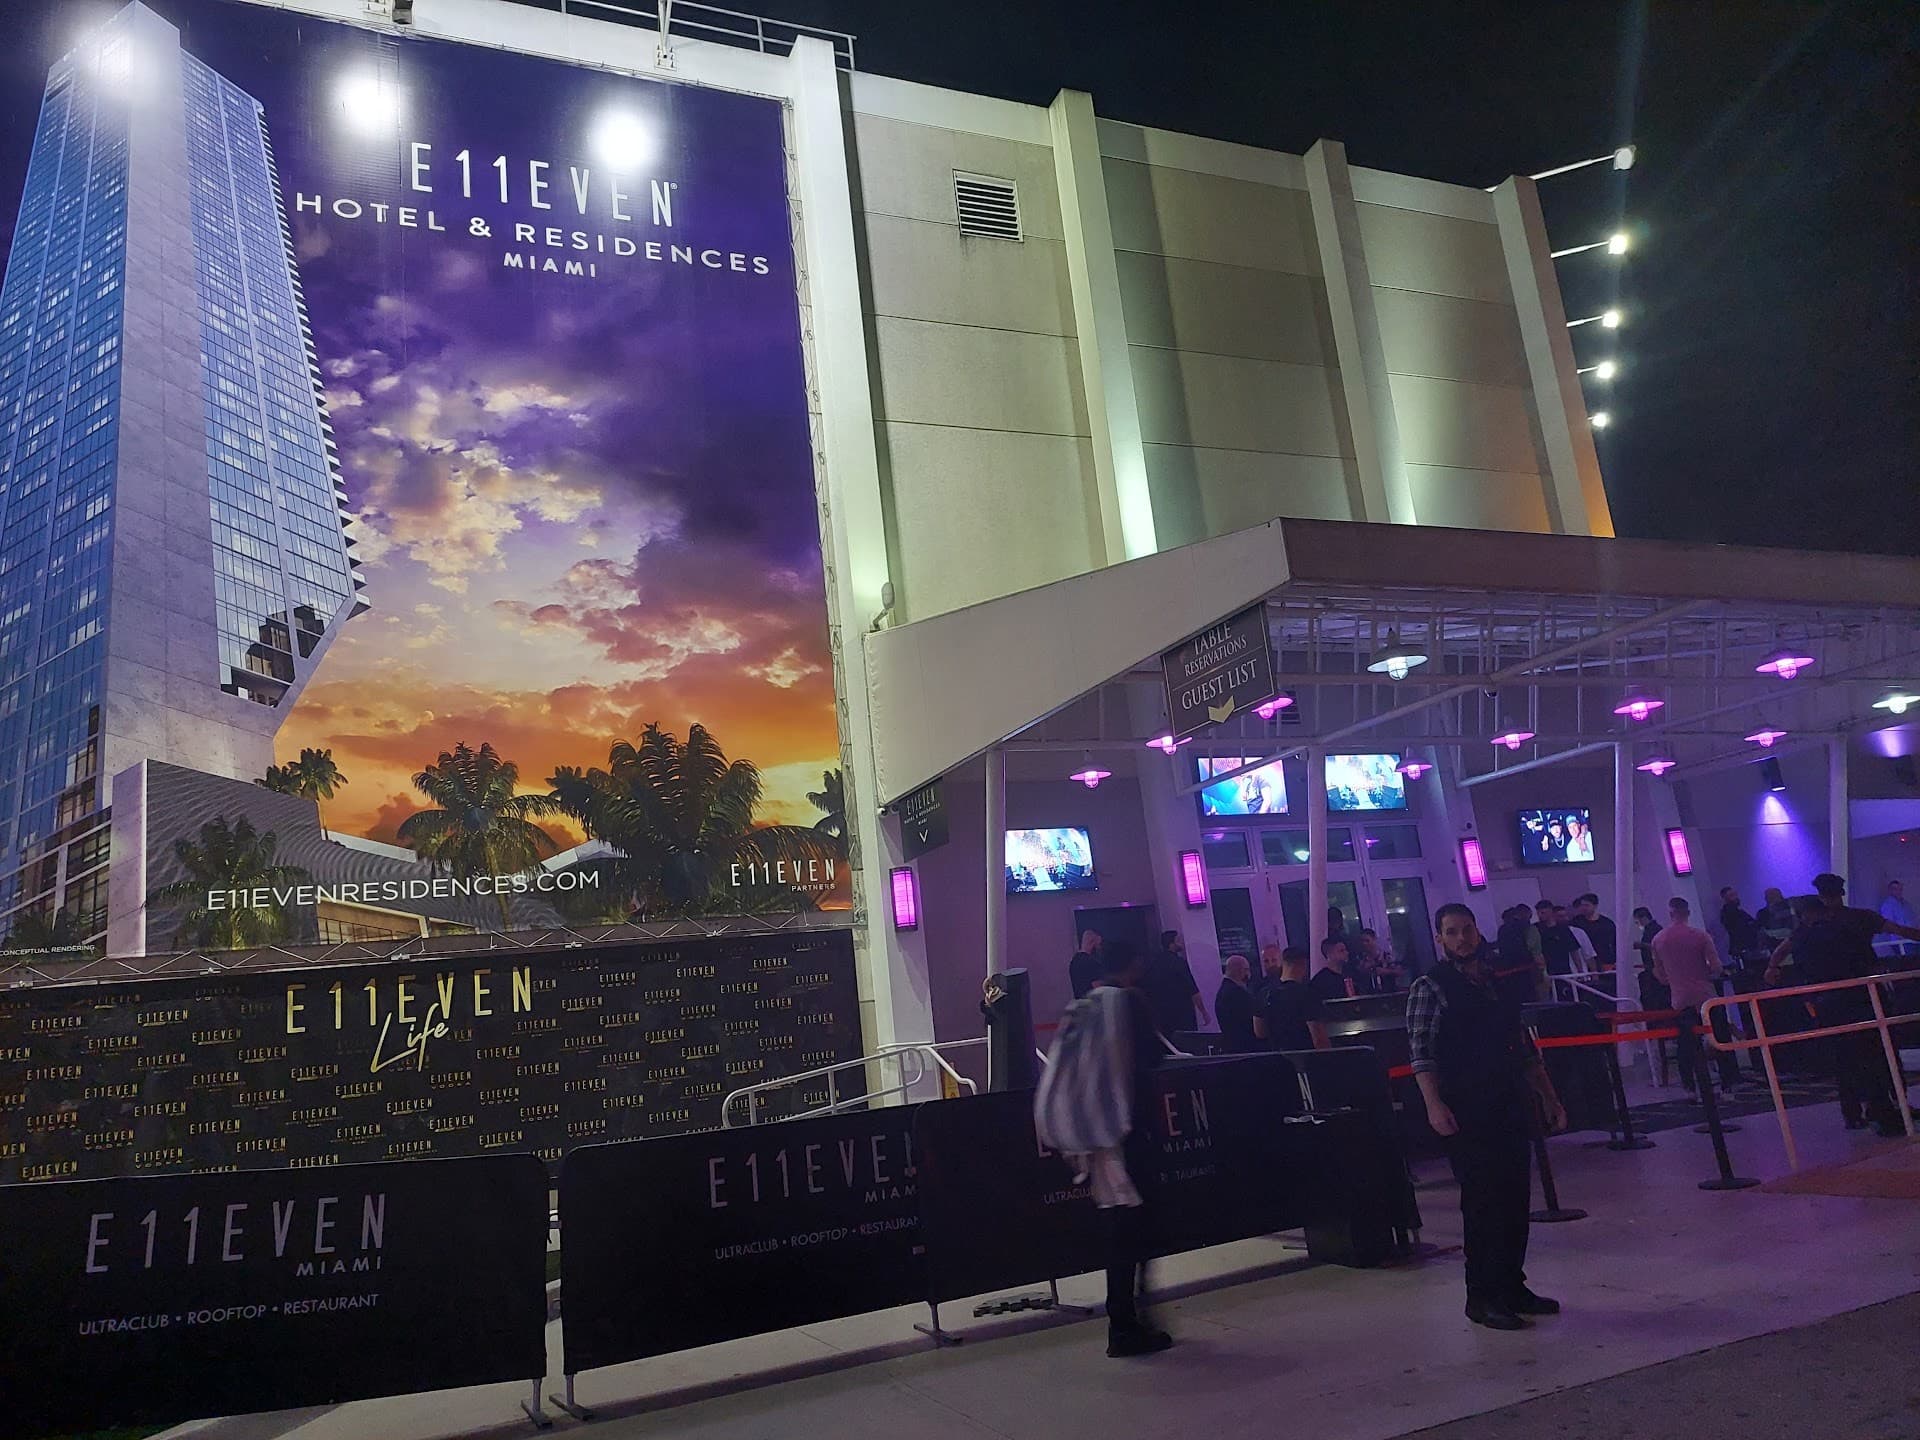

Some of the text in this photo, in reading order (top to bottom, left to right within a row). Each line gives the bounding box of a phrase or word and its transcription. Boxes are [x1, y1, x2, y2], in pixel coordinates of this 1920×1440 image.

[296, 192, 770, 275] HOTEL & RESIDENCES
[503, 252, 598, 278] MIAMI
[1184, 634, 1247, 677] RESERVATIONS
[1182, 658, 1257, 710] GUEST LIST
[207, 870, 600, 911] E11EVENRESIDENCES.COM
[731, 858, 835, 887] E11EVEN
[791, 883, 836, 892] PARTNERS
[51, 944, 95, 953] RENDERING
[286, 965, 532, 1034] E11EVEN
[370, 1002, 450, 1073] Life
[86, 1193, 386, 1274] E11EVEN
[715, 1238, 779, 1260] ULTRACLUB
[791, 1227, 848, 1248] ROOFTOP
[296, 1255, 382, 1277] MIAMI
[79, 1293, 379, 1335] ULTRACLUB ROOFTOP RESTAURANT
